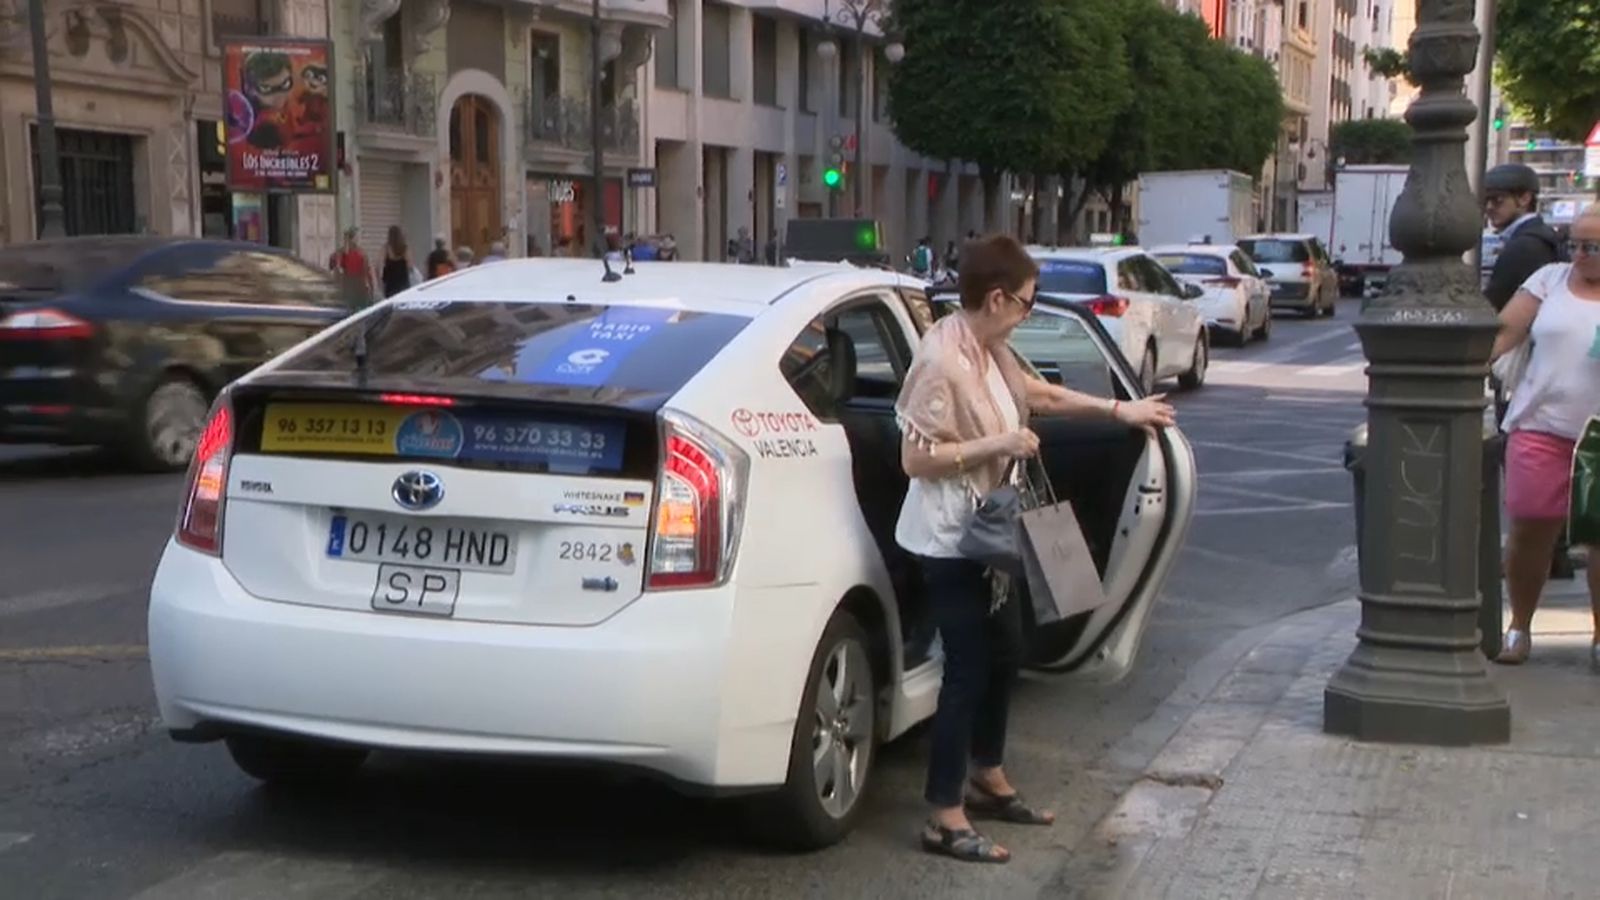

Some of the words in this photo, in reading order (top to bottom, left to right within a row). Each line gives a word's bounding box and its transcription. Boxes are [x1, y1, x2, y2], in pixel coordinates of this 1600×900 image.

[243, 151, 259, 169] LOS
[311, 153, 319, 170] 2
[591, 321, 651, 332] RADIO
[591, 331, 635, 341] TAXI
[278, 418, 297, 434] 96
[305, 418, 336, 434] 357
[342, 419, 360, 435] 13
[367, 419, 386, 435] 13
[757, 411, 817, 432] TOYOTA
[473, 424, 497, 442] 96
[504, 427, 541, 445] 370
[547, 430, 572, 447] 33
[579, 432, 606, 450] 33
[753, 438, 818, 458] VALENCIA
[563, 490, 621, 501] WHITESNAKE
[1399, 424, 1443, 565] LUCK
[350, 521, 433, 560] 0148
[443, 527, 510, 567] HND
[559, 541, 612, 562] 2842
[385, 572, 447, 607] SP
